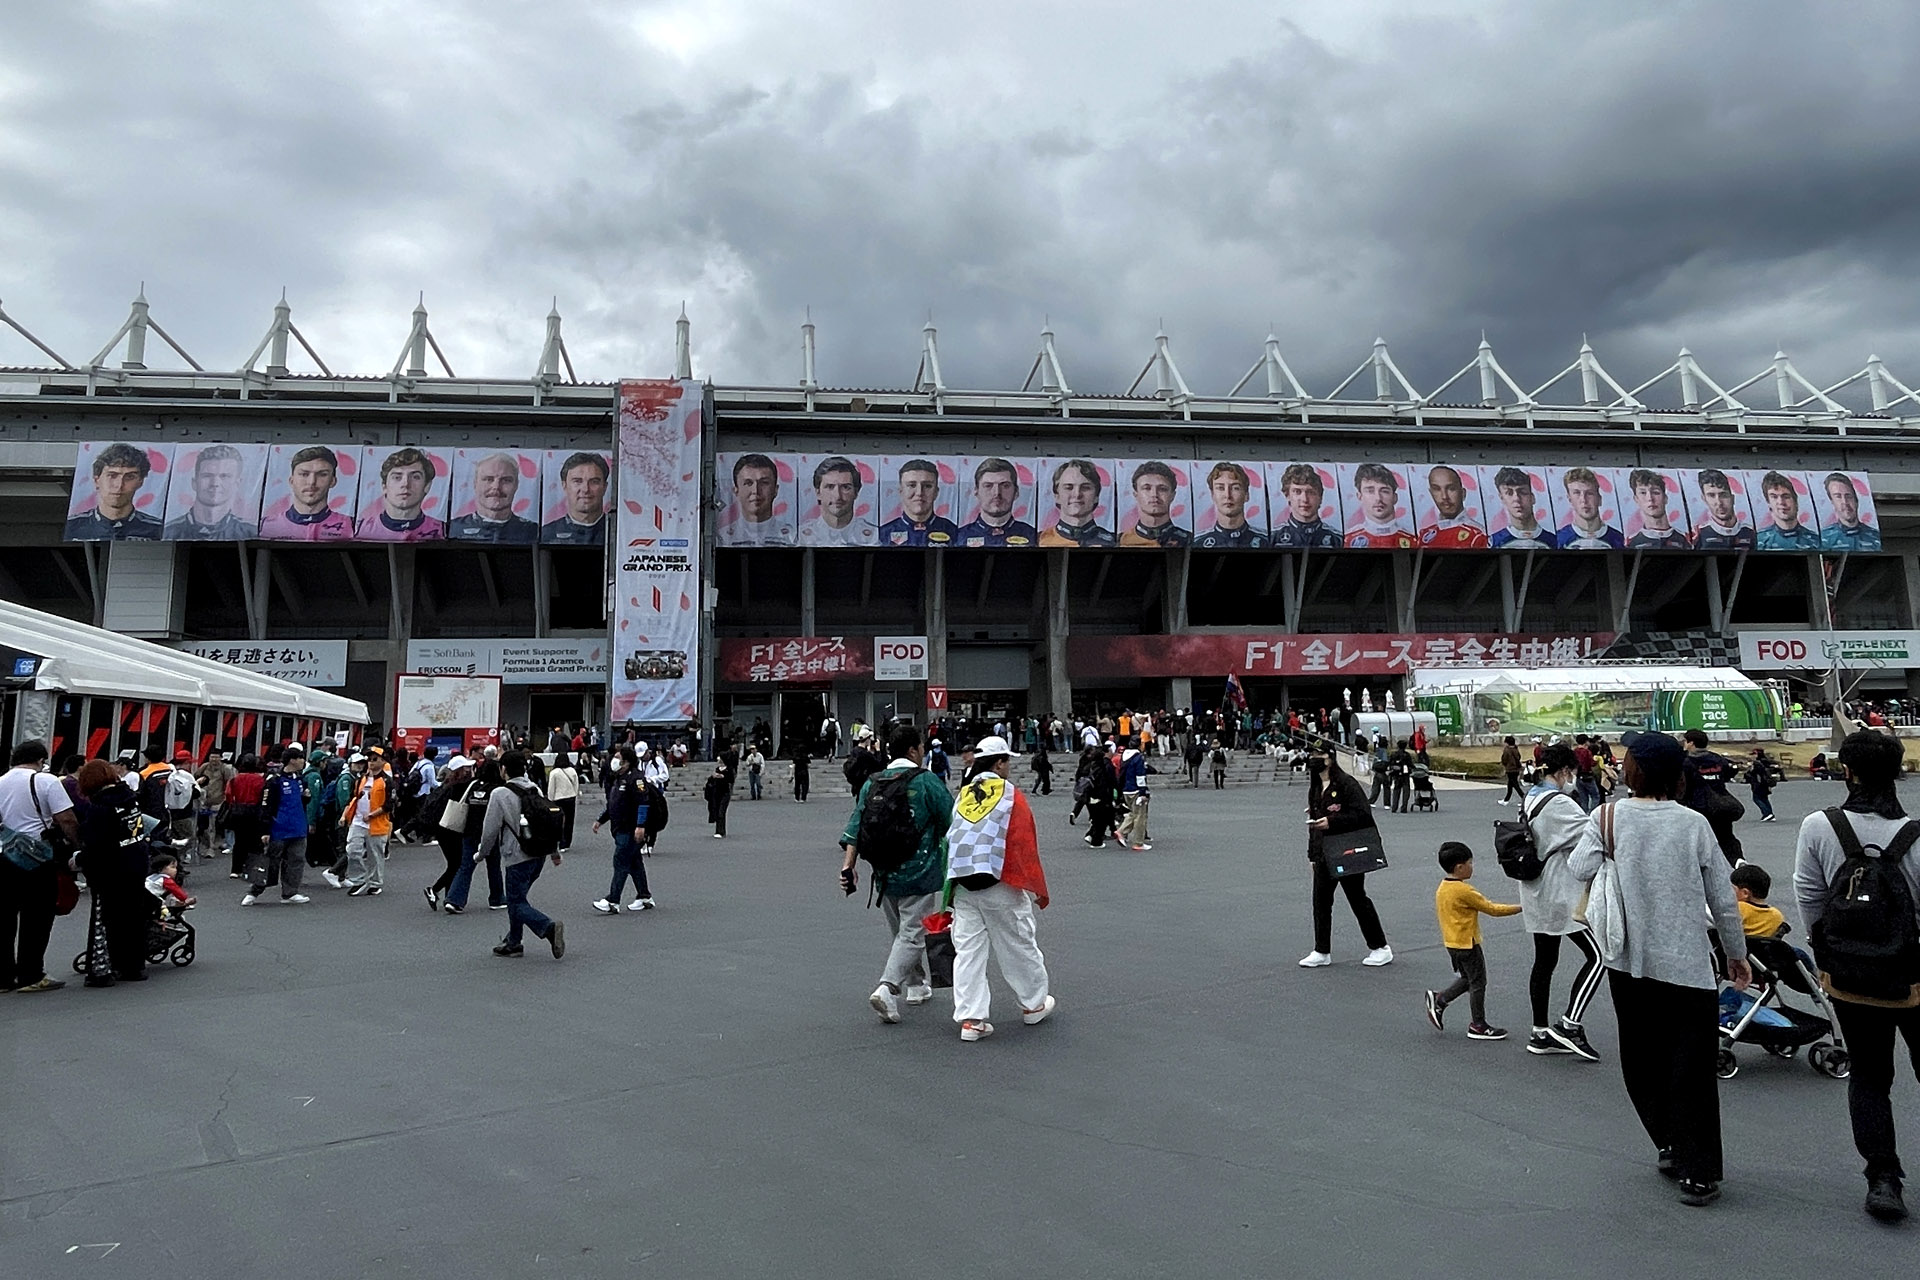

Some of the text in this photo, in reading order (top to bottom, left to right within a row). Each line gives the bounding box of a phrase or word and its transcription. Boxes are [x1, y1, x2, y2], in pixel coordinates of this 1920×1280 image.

[628, 554, 687, 563] JAPANESE
[622, 563, 693, 572] GRAND PRIX
[433, 648, 476, 658] SoftBank
[503, 648, 579, 658] Event Supporter
[783, 636, 846, 661] 全レース
[880, 643, 925, 660] FOD
[1757, 640, 1807, 661] FOD
[1301, 639, 1414, 671] 全レース
[418, 666, 462, 674] ERICSSON
[503, 665, 546, 673] Japanese
[547, 665, 575, 673] Grand
[577, 665, 594, 673] Prix
[931, 691, 944, 708] V
[1702, 693, 1724, 702] More
[1701, 711, 1728, 721] race
